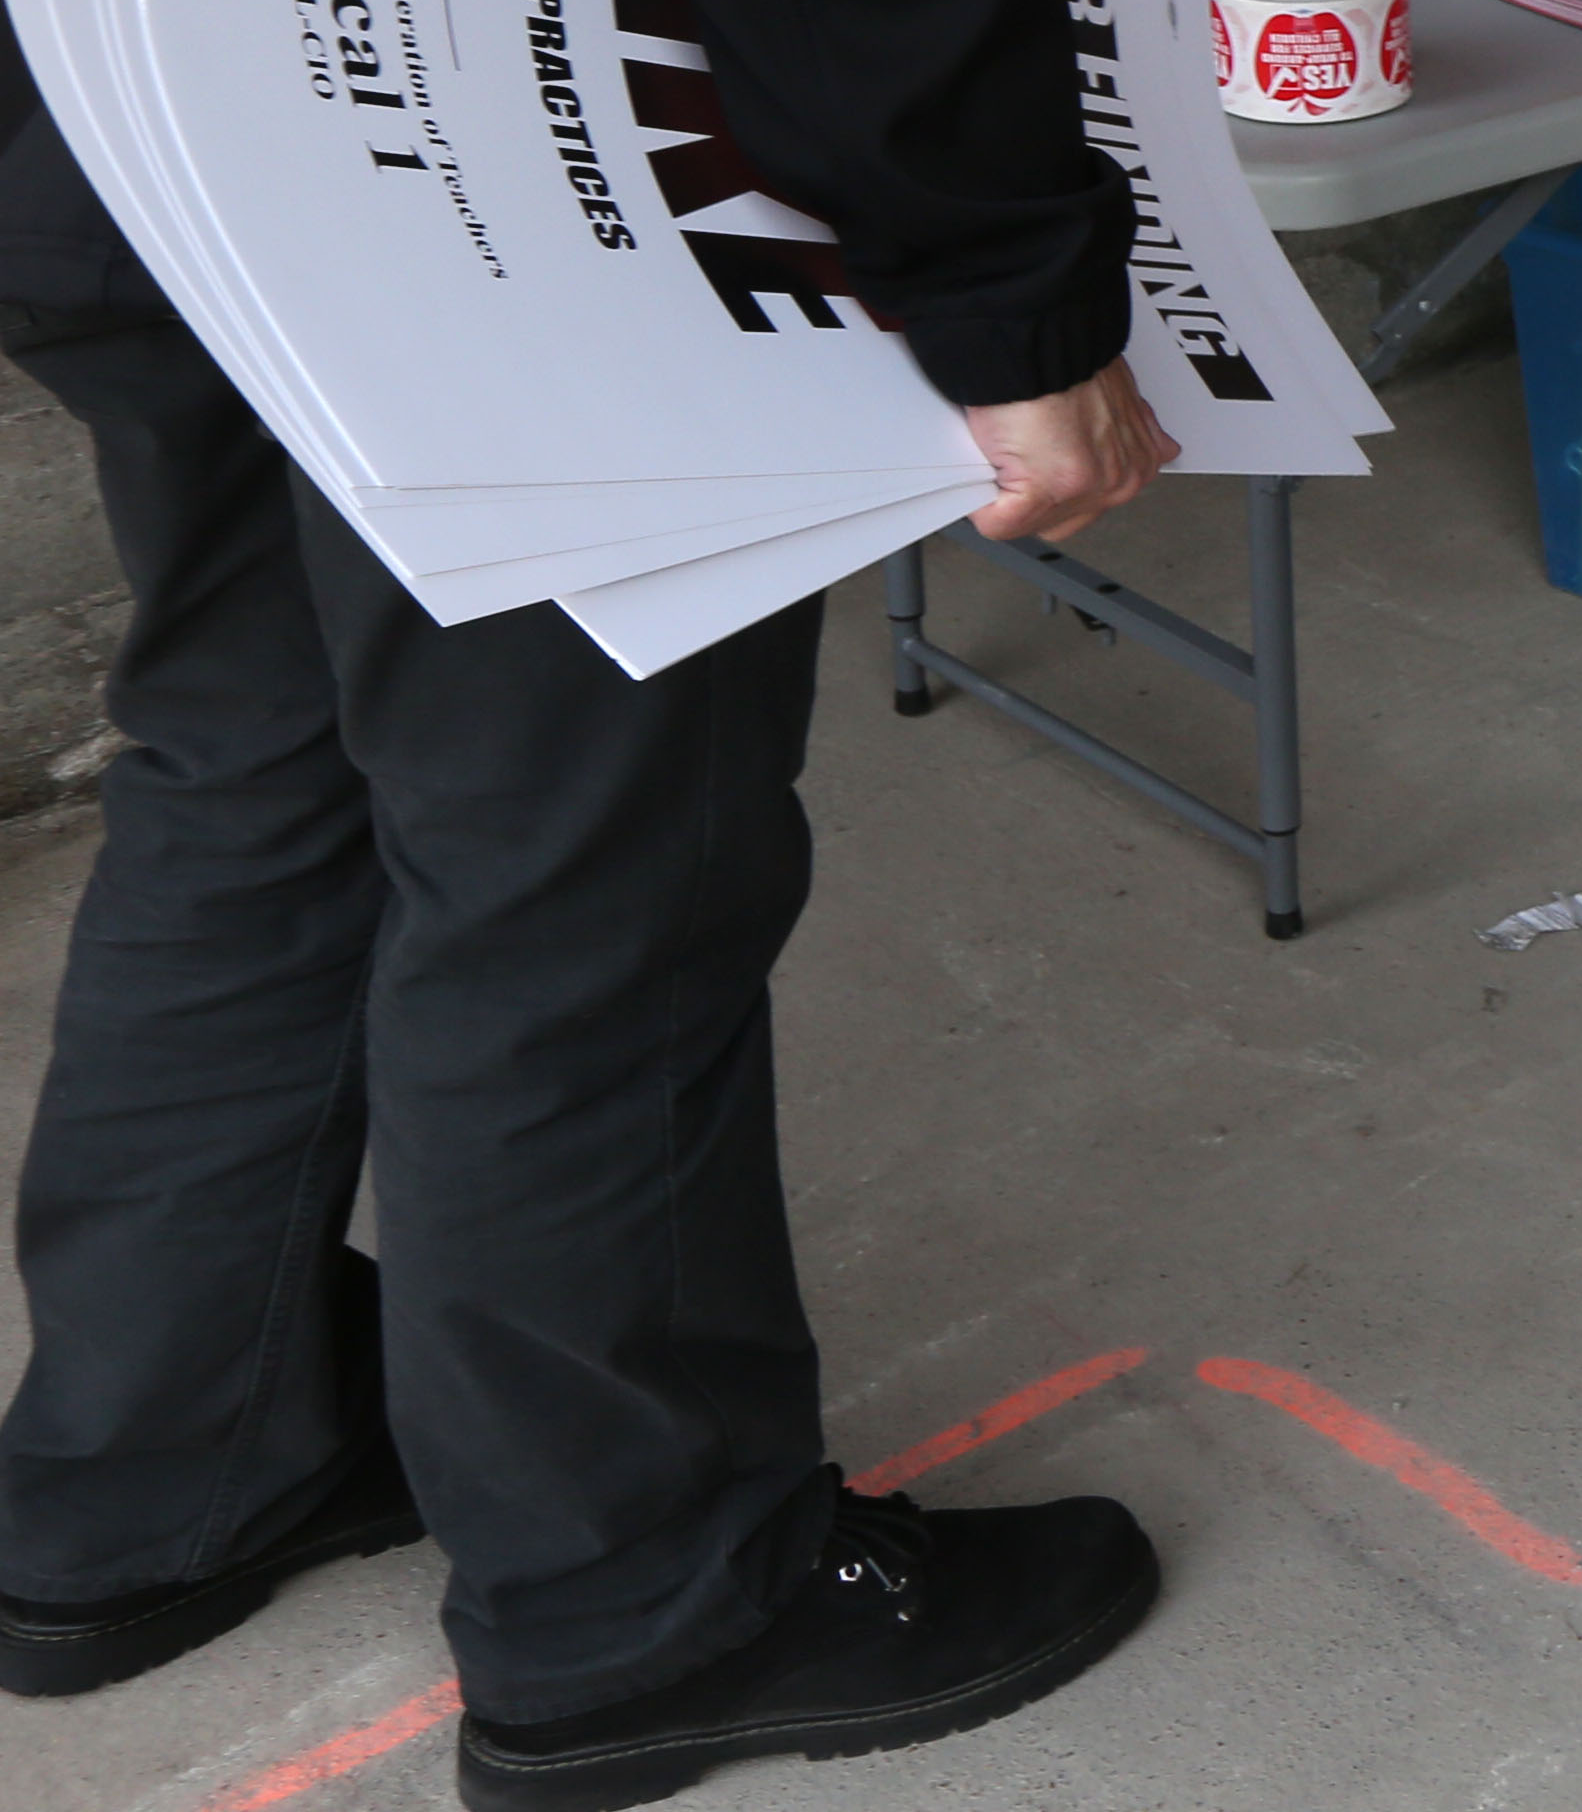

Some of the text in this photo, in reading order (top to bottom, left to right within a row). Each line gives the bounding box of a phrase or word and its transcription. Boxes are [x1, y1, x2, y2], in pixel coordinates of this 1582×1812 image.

[1268, 31, 1340, 44] ALL CHILDREN
[1268, 42, 1343, 54] SERVICES FOR
[1302, 64, 1353, 91] YES
[365, 140, 431, 174] 1
[421, 118, 451, 148] of
[436, 149, 510, 281] Teachers
